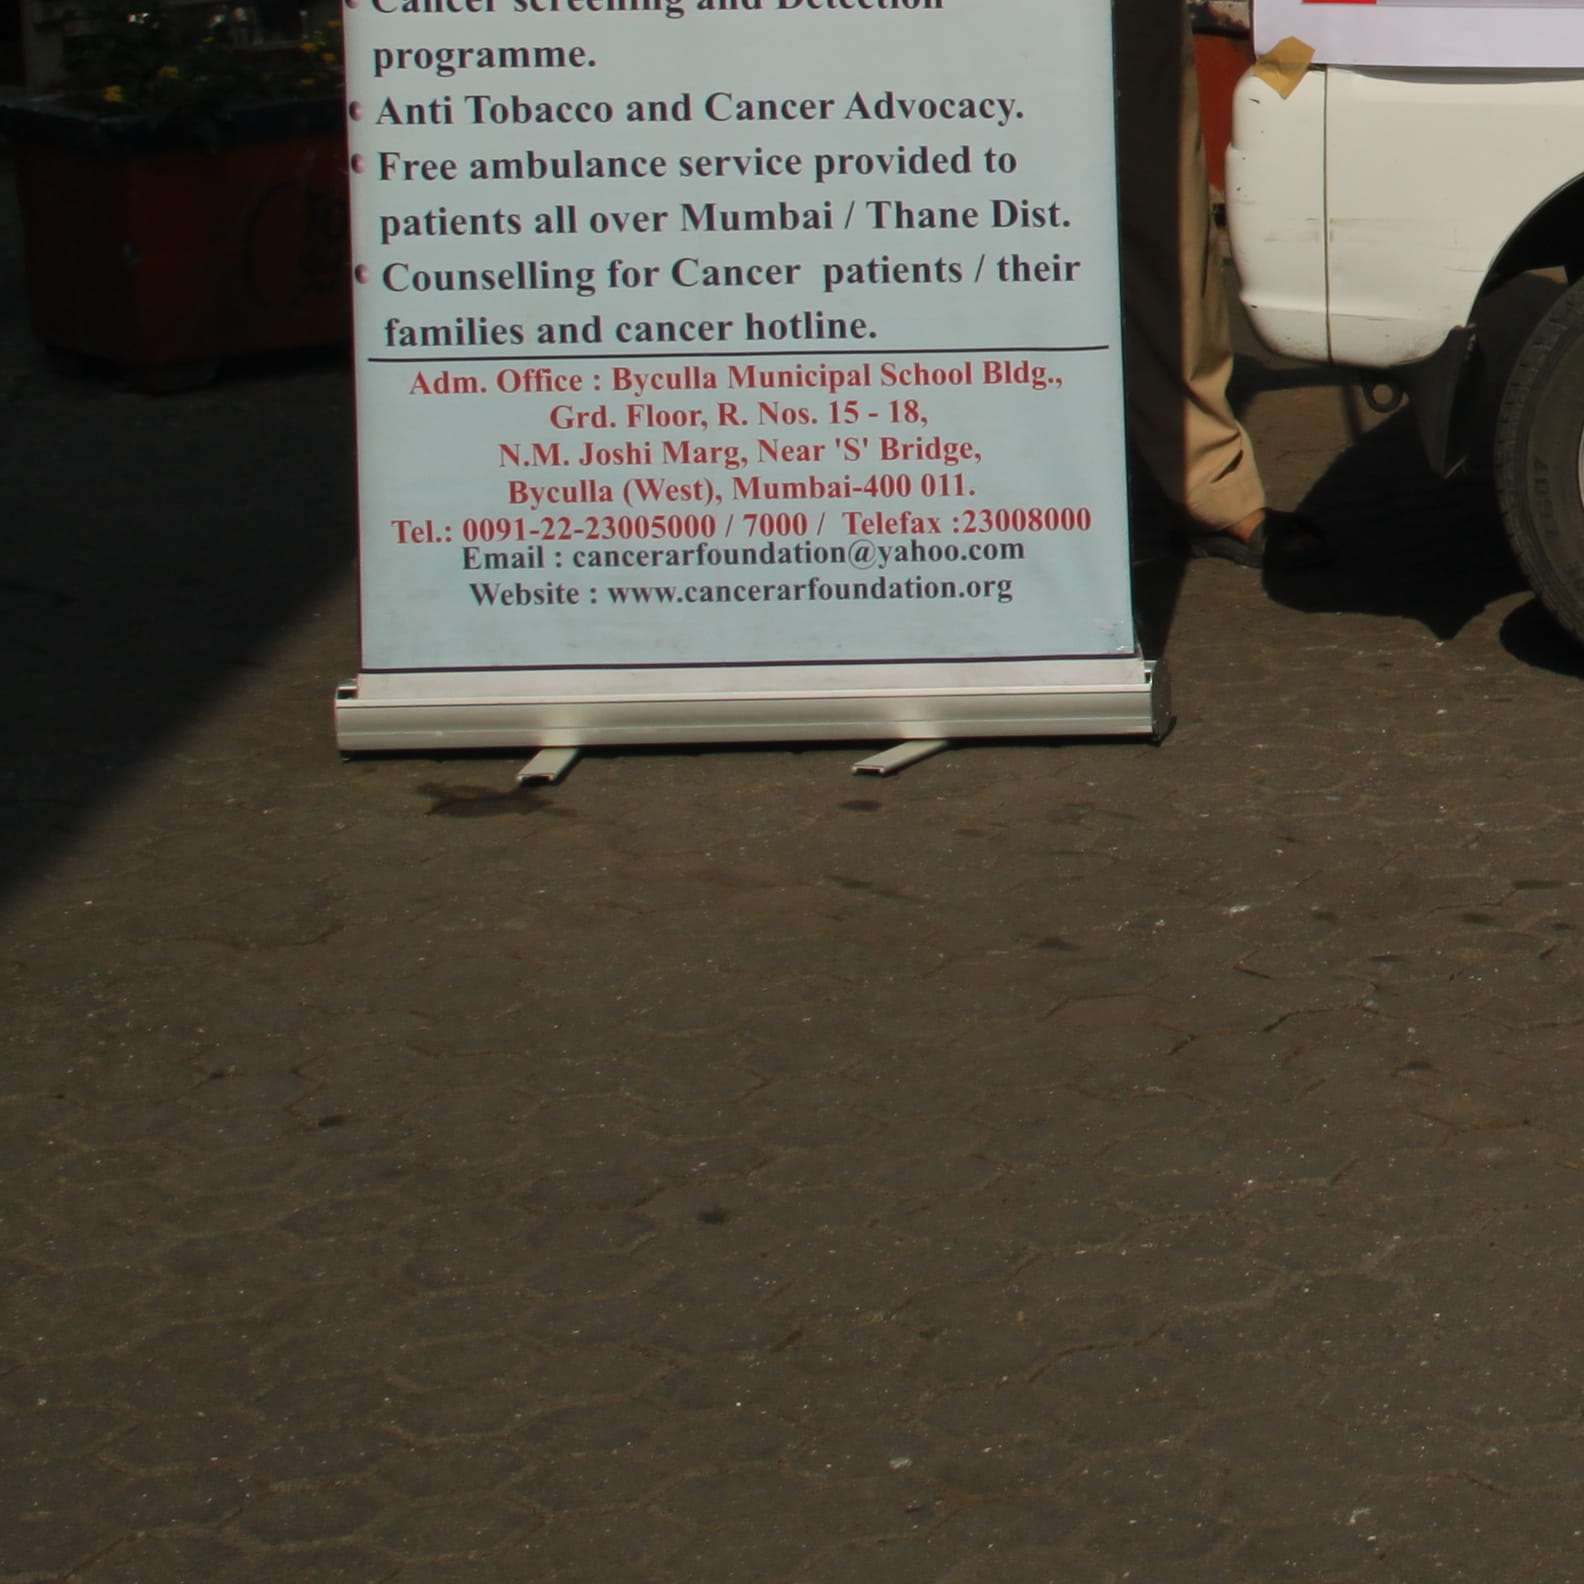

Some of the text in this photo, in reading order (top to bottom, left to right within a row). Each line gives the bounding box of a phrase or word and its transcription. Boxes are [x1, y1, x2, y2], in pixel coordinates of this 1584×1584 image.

[374, 47, 597, 79] programme.
[376, 92, 1025, 128] Anti Tobacco and Cancer Advocacy.
[379, 146, 1018, 185] Free ambulance service provided to
[381, 200, 1072, 246] patients all over Mumbai Thane Dist.
[383, 254, 1082, 298] Counselling for Cancer patients their
[386, 311, 878, 348] families and cancer hotline.
[464, 539, 1026, 571] Email cancerarfoundation@yahoo.com
[470, 576, 1014, 607] Website www.cancerarfoundation.org
